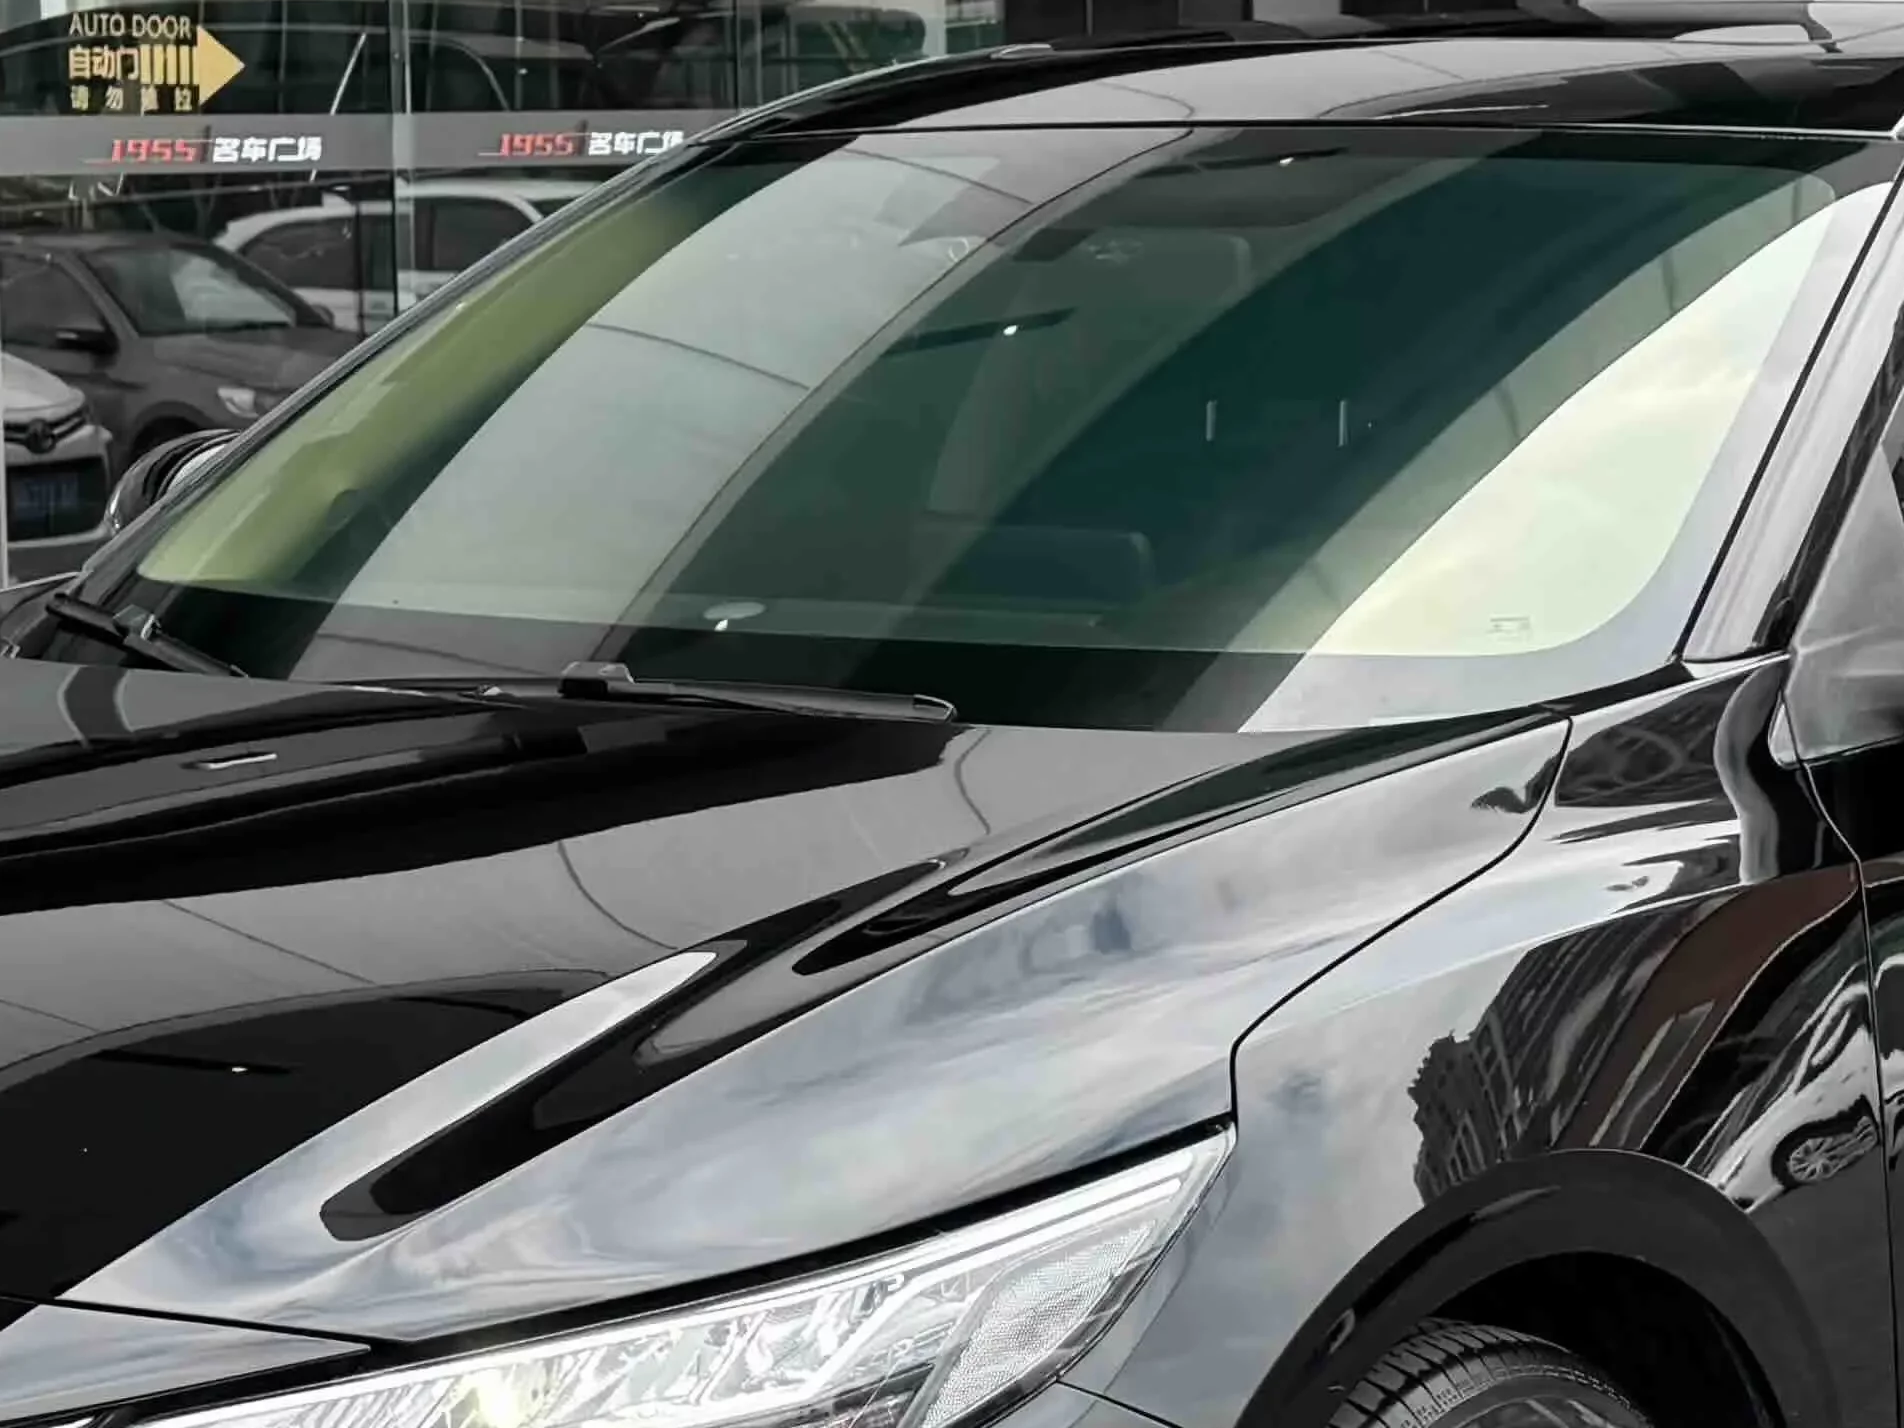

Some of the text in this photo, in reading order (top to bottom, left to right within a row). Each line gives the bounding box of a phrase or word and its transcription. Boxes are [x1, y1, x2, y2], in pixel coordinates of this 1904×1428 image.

[69, 12, 192, 40] AUTO DOOR
[69, 44, 139, 80] 自动门
[111, 136, 323, 163] 1955 名车广场
[500, 133, 575, 157] 1955
